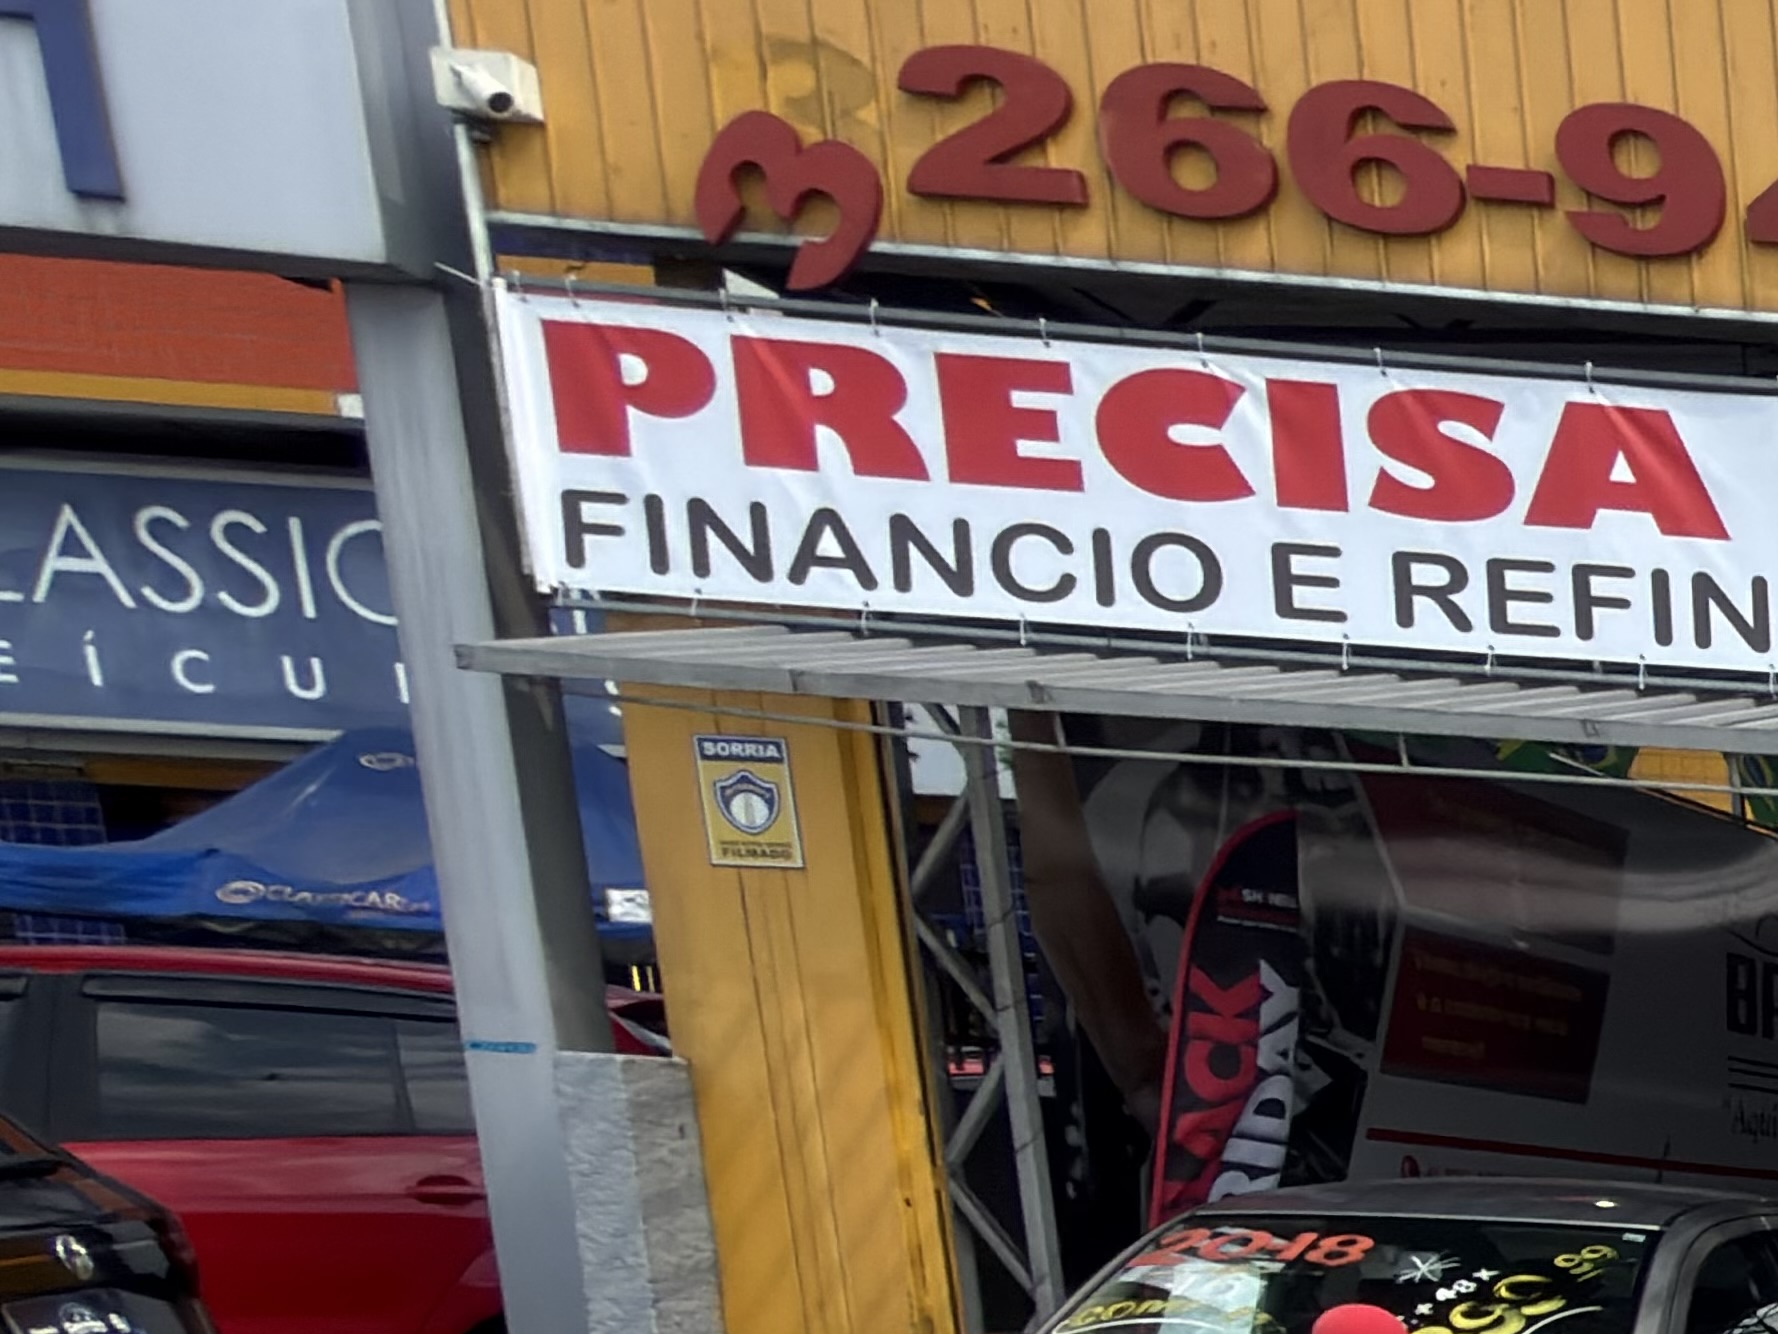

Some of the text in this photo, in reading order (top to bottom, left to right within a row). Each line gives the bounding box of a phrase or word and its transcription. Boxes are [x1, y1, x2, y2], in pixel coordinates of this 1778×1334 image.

[541, 318, 1732, 542] PRECISA
[0, 502, 399, 627] ASSIC
[560, 490, 1224, 615] FINANCIO
[1271, 541, 1348, 624] E
[702, 741, 781, 758] SORRIA
[1125, 1226, 1376, 1268] 2018
